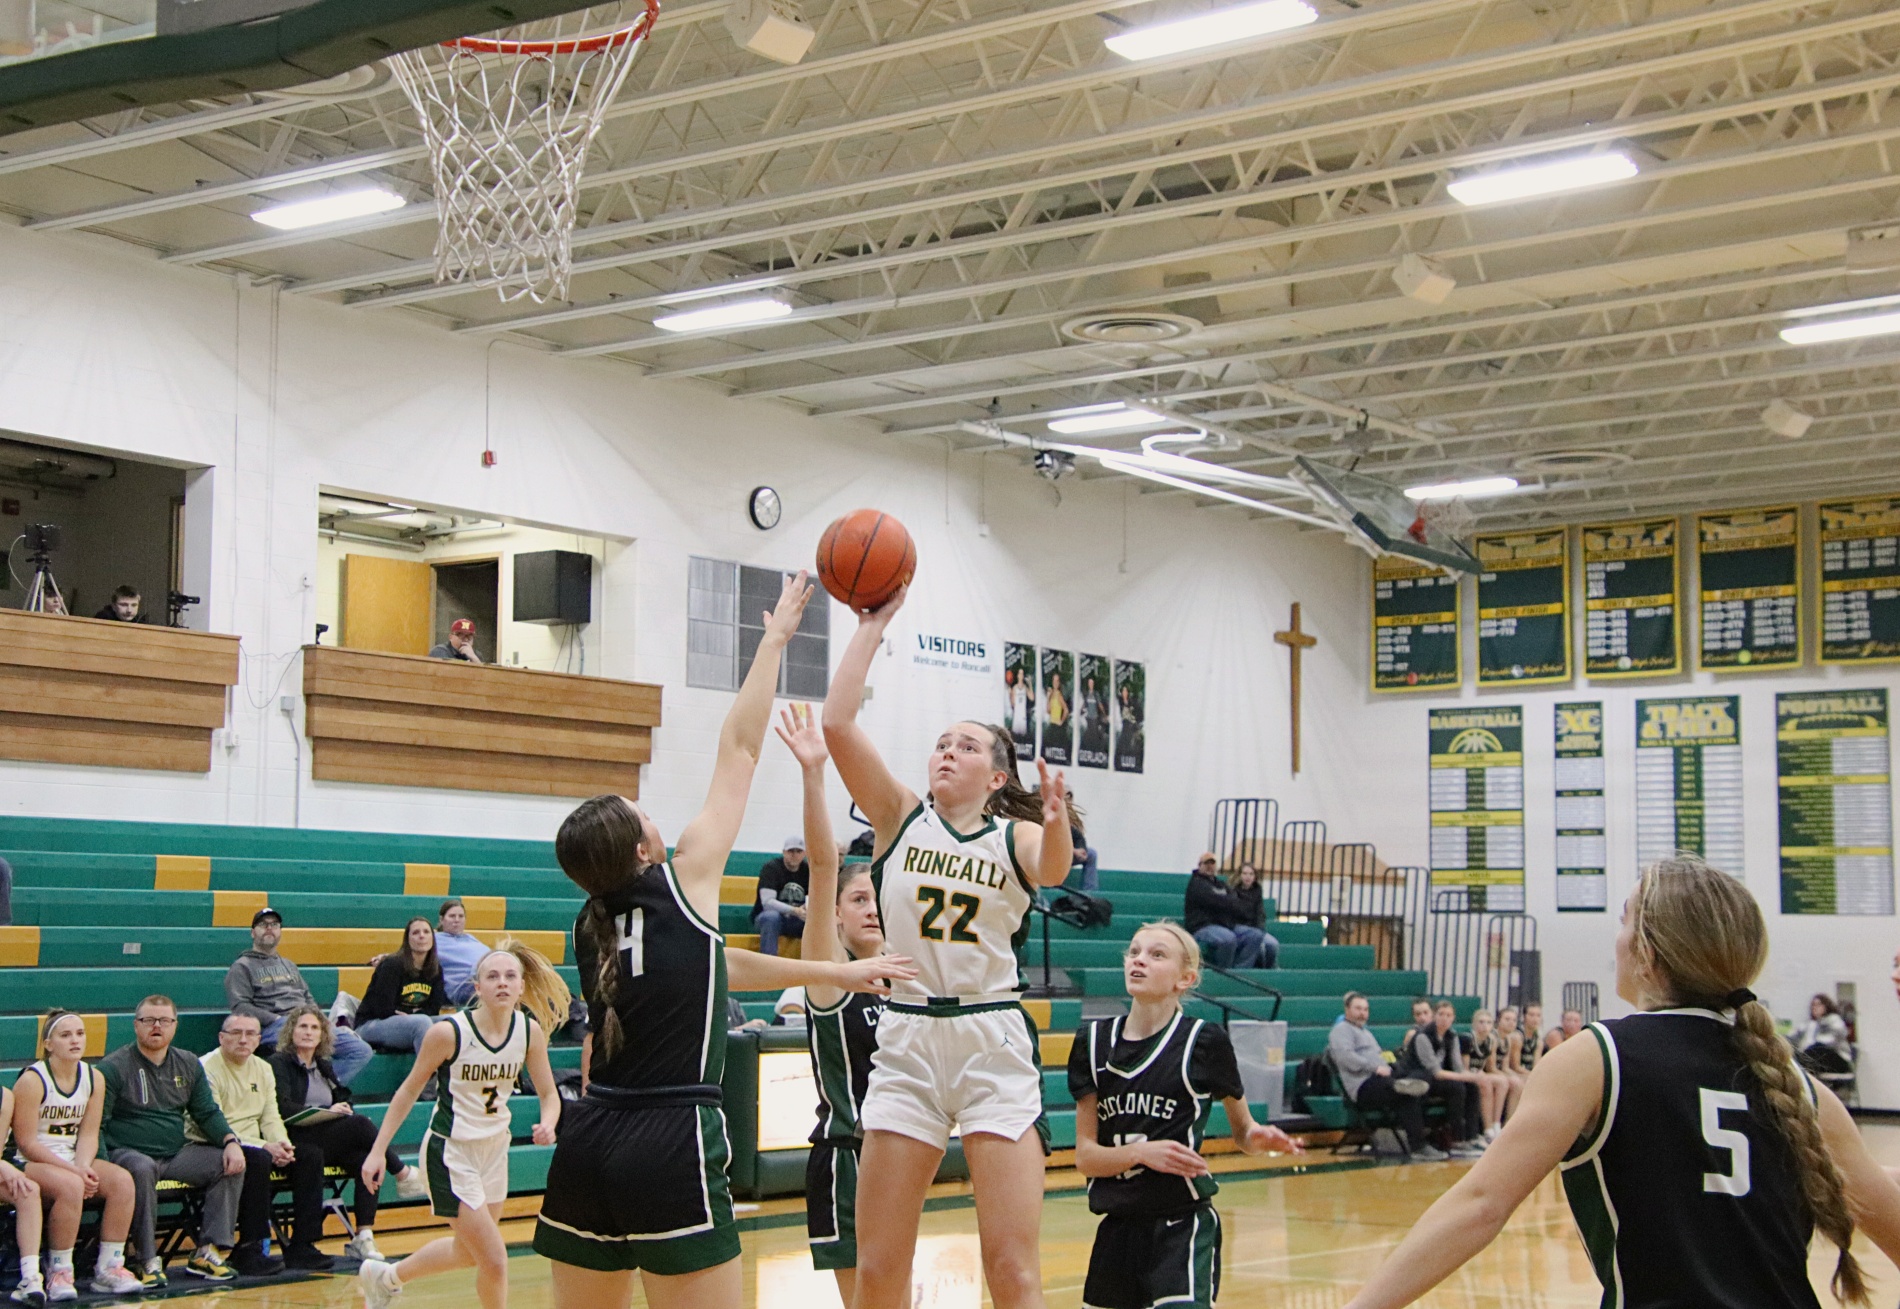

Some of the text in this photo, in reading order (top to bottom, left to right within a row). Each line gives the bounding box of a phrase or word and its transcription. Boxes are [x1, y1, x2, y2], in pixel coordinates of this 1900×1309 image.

[461, 621, 471, 630] N
[918, 634, 986, 658] VISITORS
[913, 655, 949, 668] Welcome
[951, 661, 960, 669] to
[1646, 702, 1732, 722] TRACK
[1778, 696, 1884, 715] FOOTBALL
[1429, 712, 1522, 730] BASKETBALL
[1558, 709, 1601, 734] XC
[1641, 718, 1736, 739] & FIELD
[903, 846, 1007, 891] RONCALLI
[916, 884, 982, 945] 22
[614, 906, 644, 978] 4
[250, 1083, 259, 1093] R
[481, 1085, 499, 1117] 2
[1097, 1092, 1178, 1121] CYCLONES
[1699, 1087, 1751, 1197] 5
